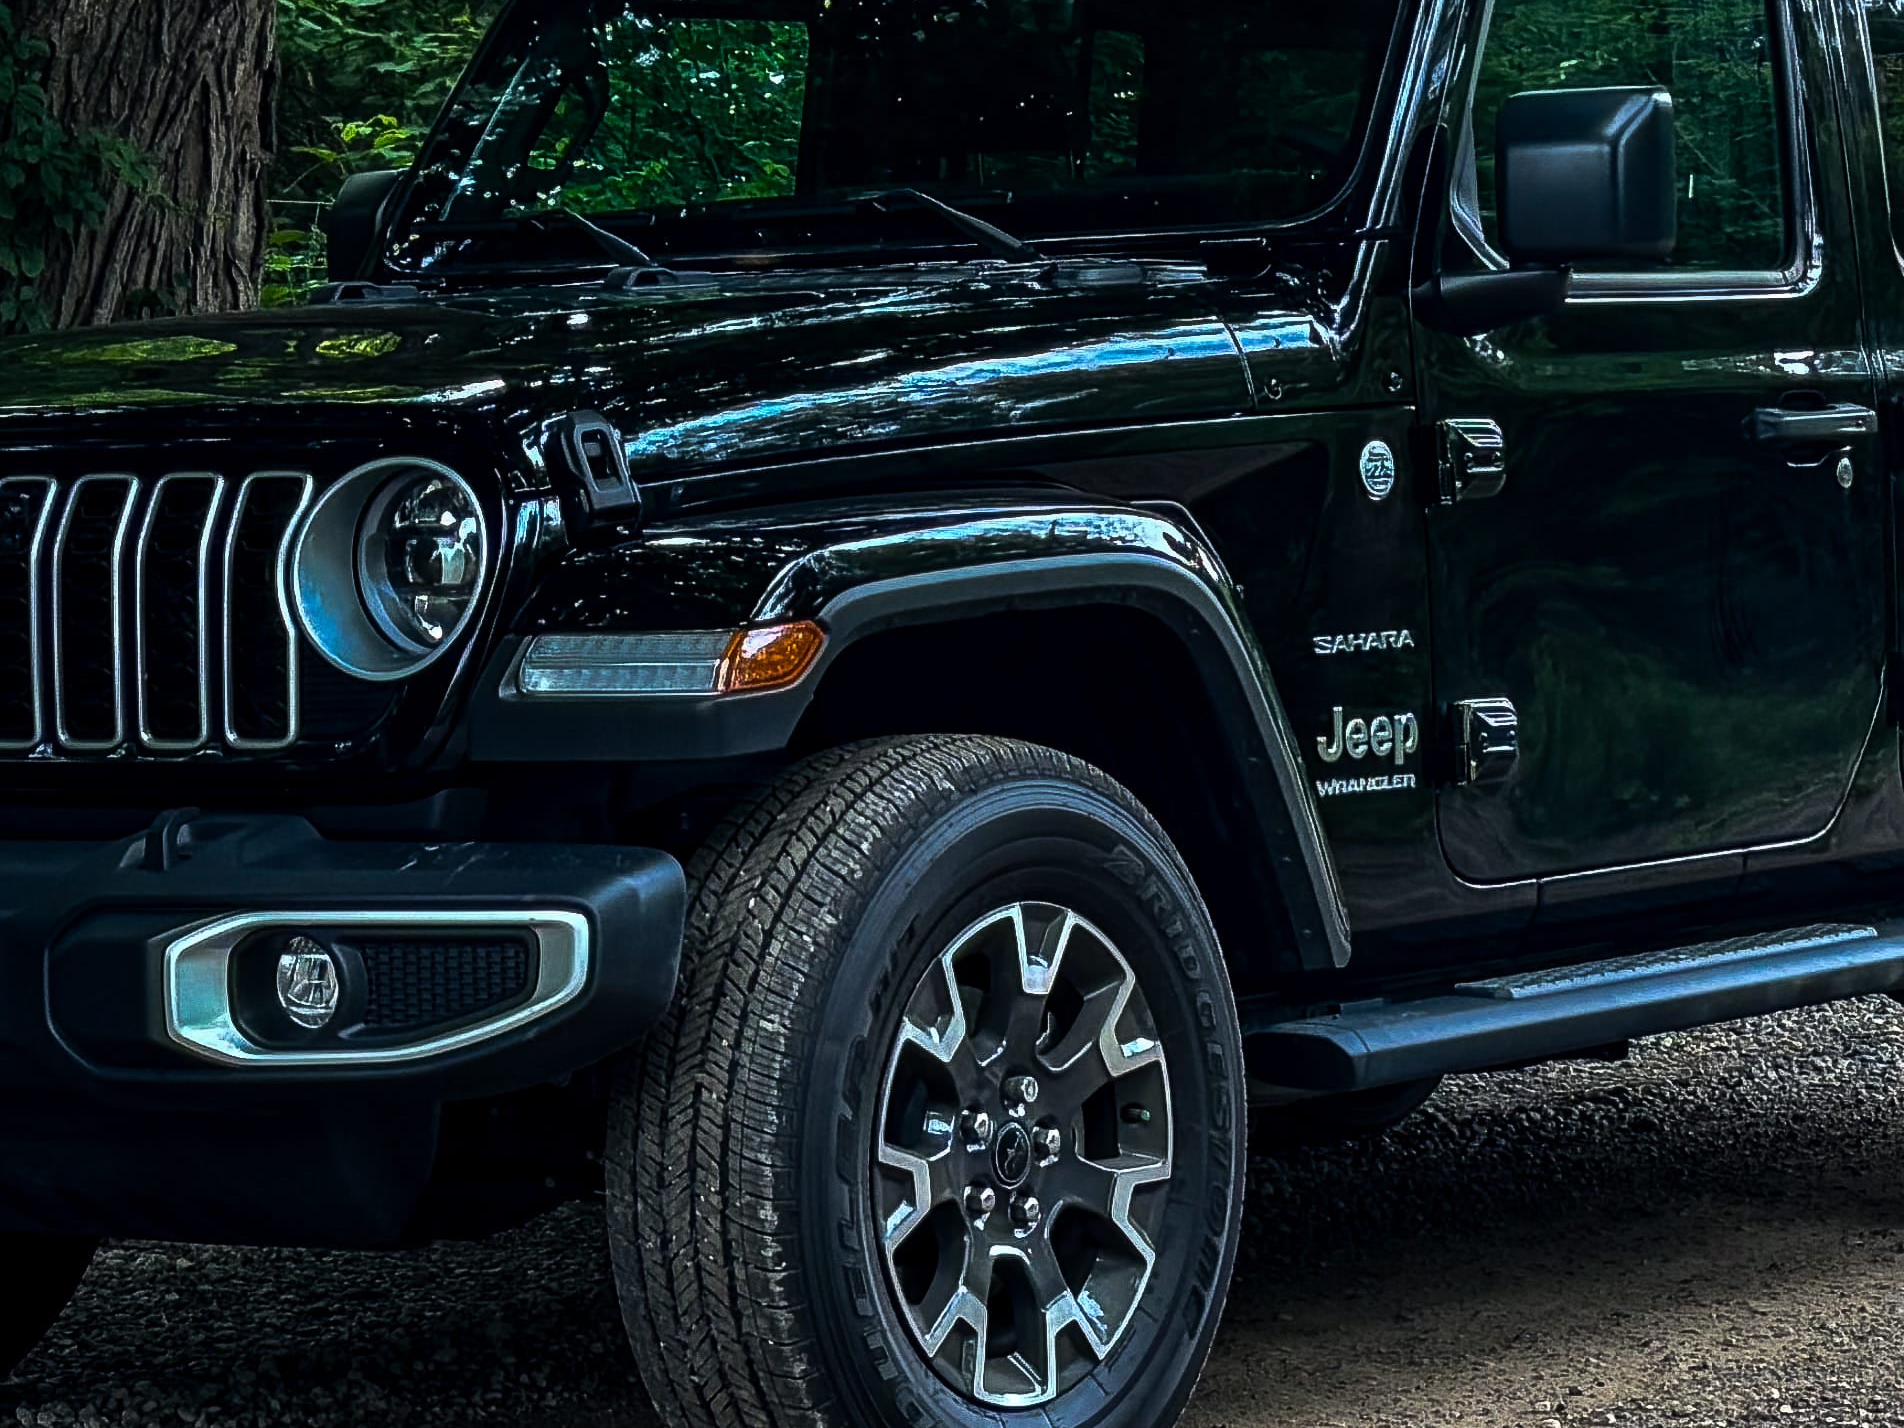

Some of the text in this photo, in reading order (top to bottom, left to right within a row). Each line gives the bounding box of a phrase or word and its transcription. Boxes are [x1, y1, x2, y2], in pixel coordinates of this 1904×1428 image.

[1313, 629, 1415, 654] SAHARA
[1317, 706, 1418, 764] Jeep
[1315, 774, 1416, 797] WRANGLER
[1103, 842, 1234, 1341] BRIDGESTONE
